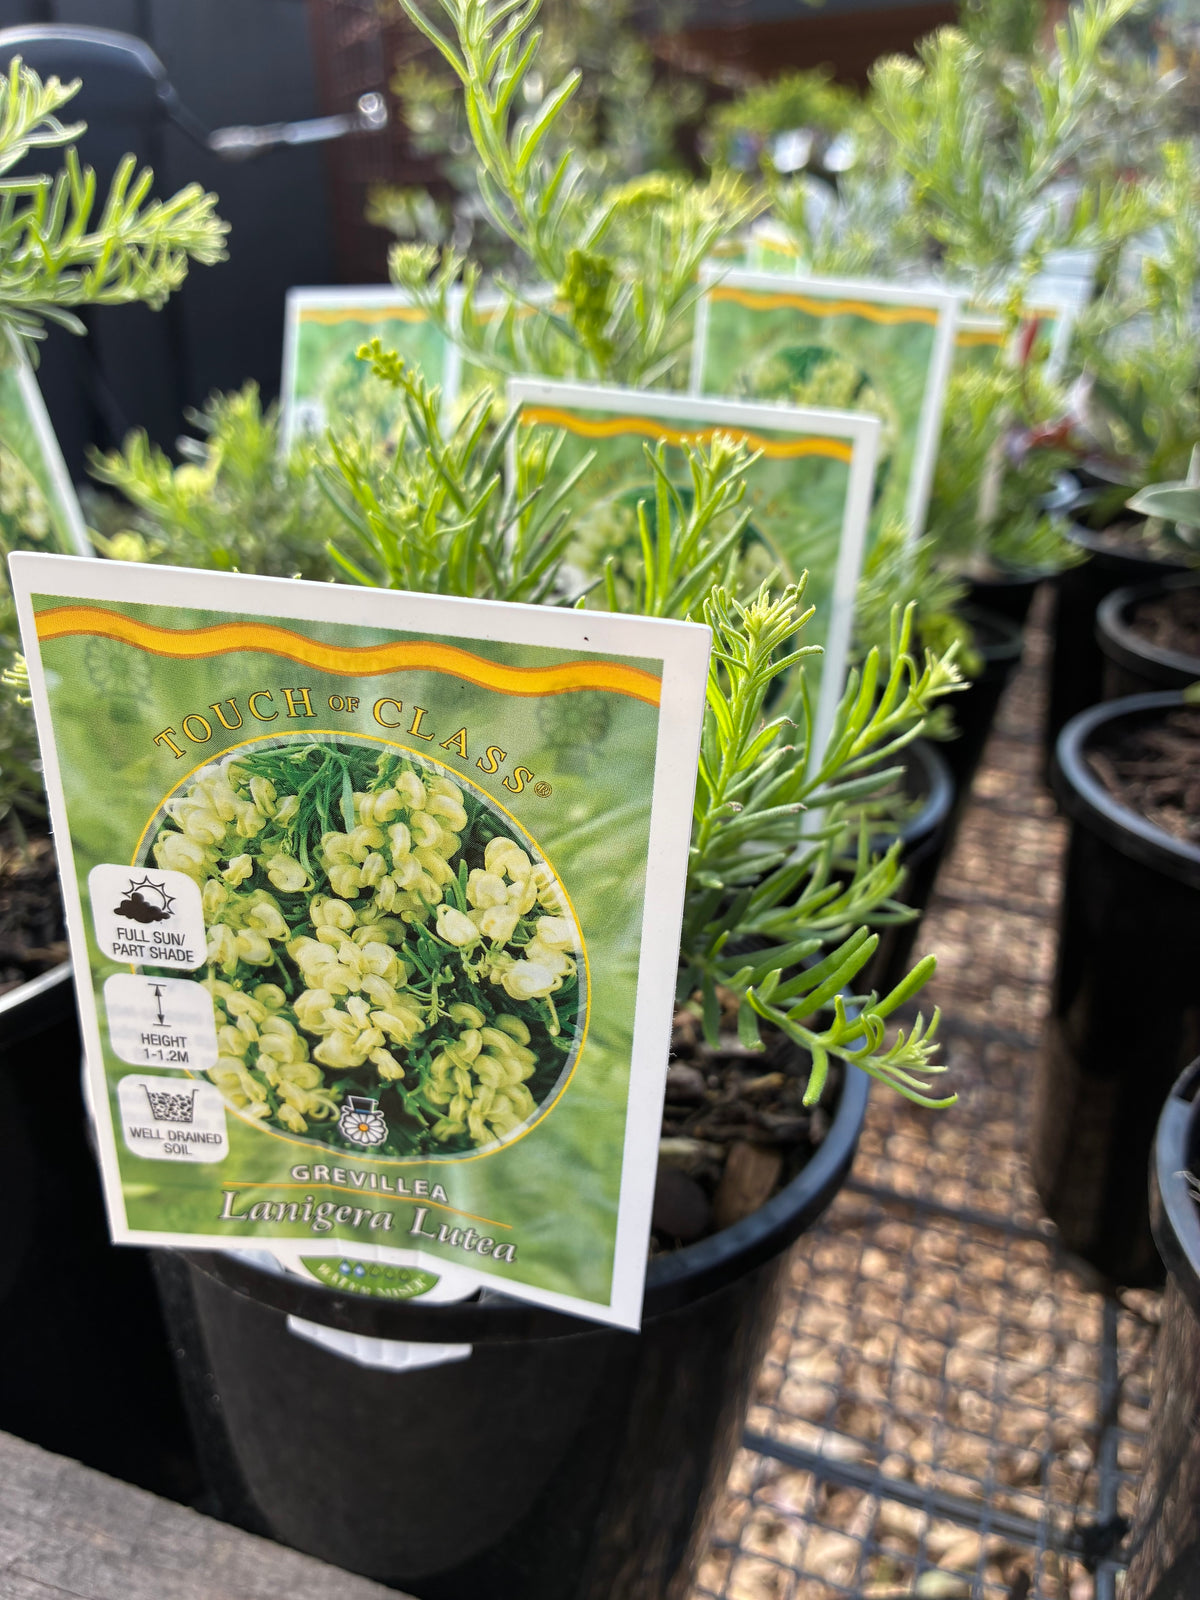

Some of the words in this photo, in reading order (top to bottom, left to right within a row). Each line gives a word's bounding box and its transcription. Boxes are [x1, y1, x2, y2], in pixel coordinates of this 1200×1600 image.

[153, 687, 317, 760] TOUCH
[328, 694, 360, 713] OF
[117, 928, 150, 943] FULL
[153, 931, 186, 947] SUN/
[112, 943, 145, 957] PART
[149, 946, 195, 963] SHADE
[141, 1033, 187, 1048] HEIGHT
[144, 1049, 189, 1063] 1-1.2M
[129, 1127, 164, 1140] WELL
[168, 1130, 222, 1145] DRAINED
[164, 1143, 192, 1156] SOIL
[290, 1164, 449, 1203] GREVILLEA
[217, 1190, 395, 1232] Lanigera
[409, 1206, 518, 1264] Lutea
